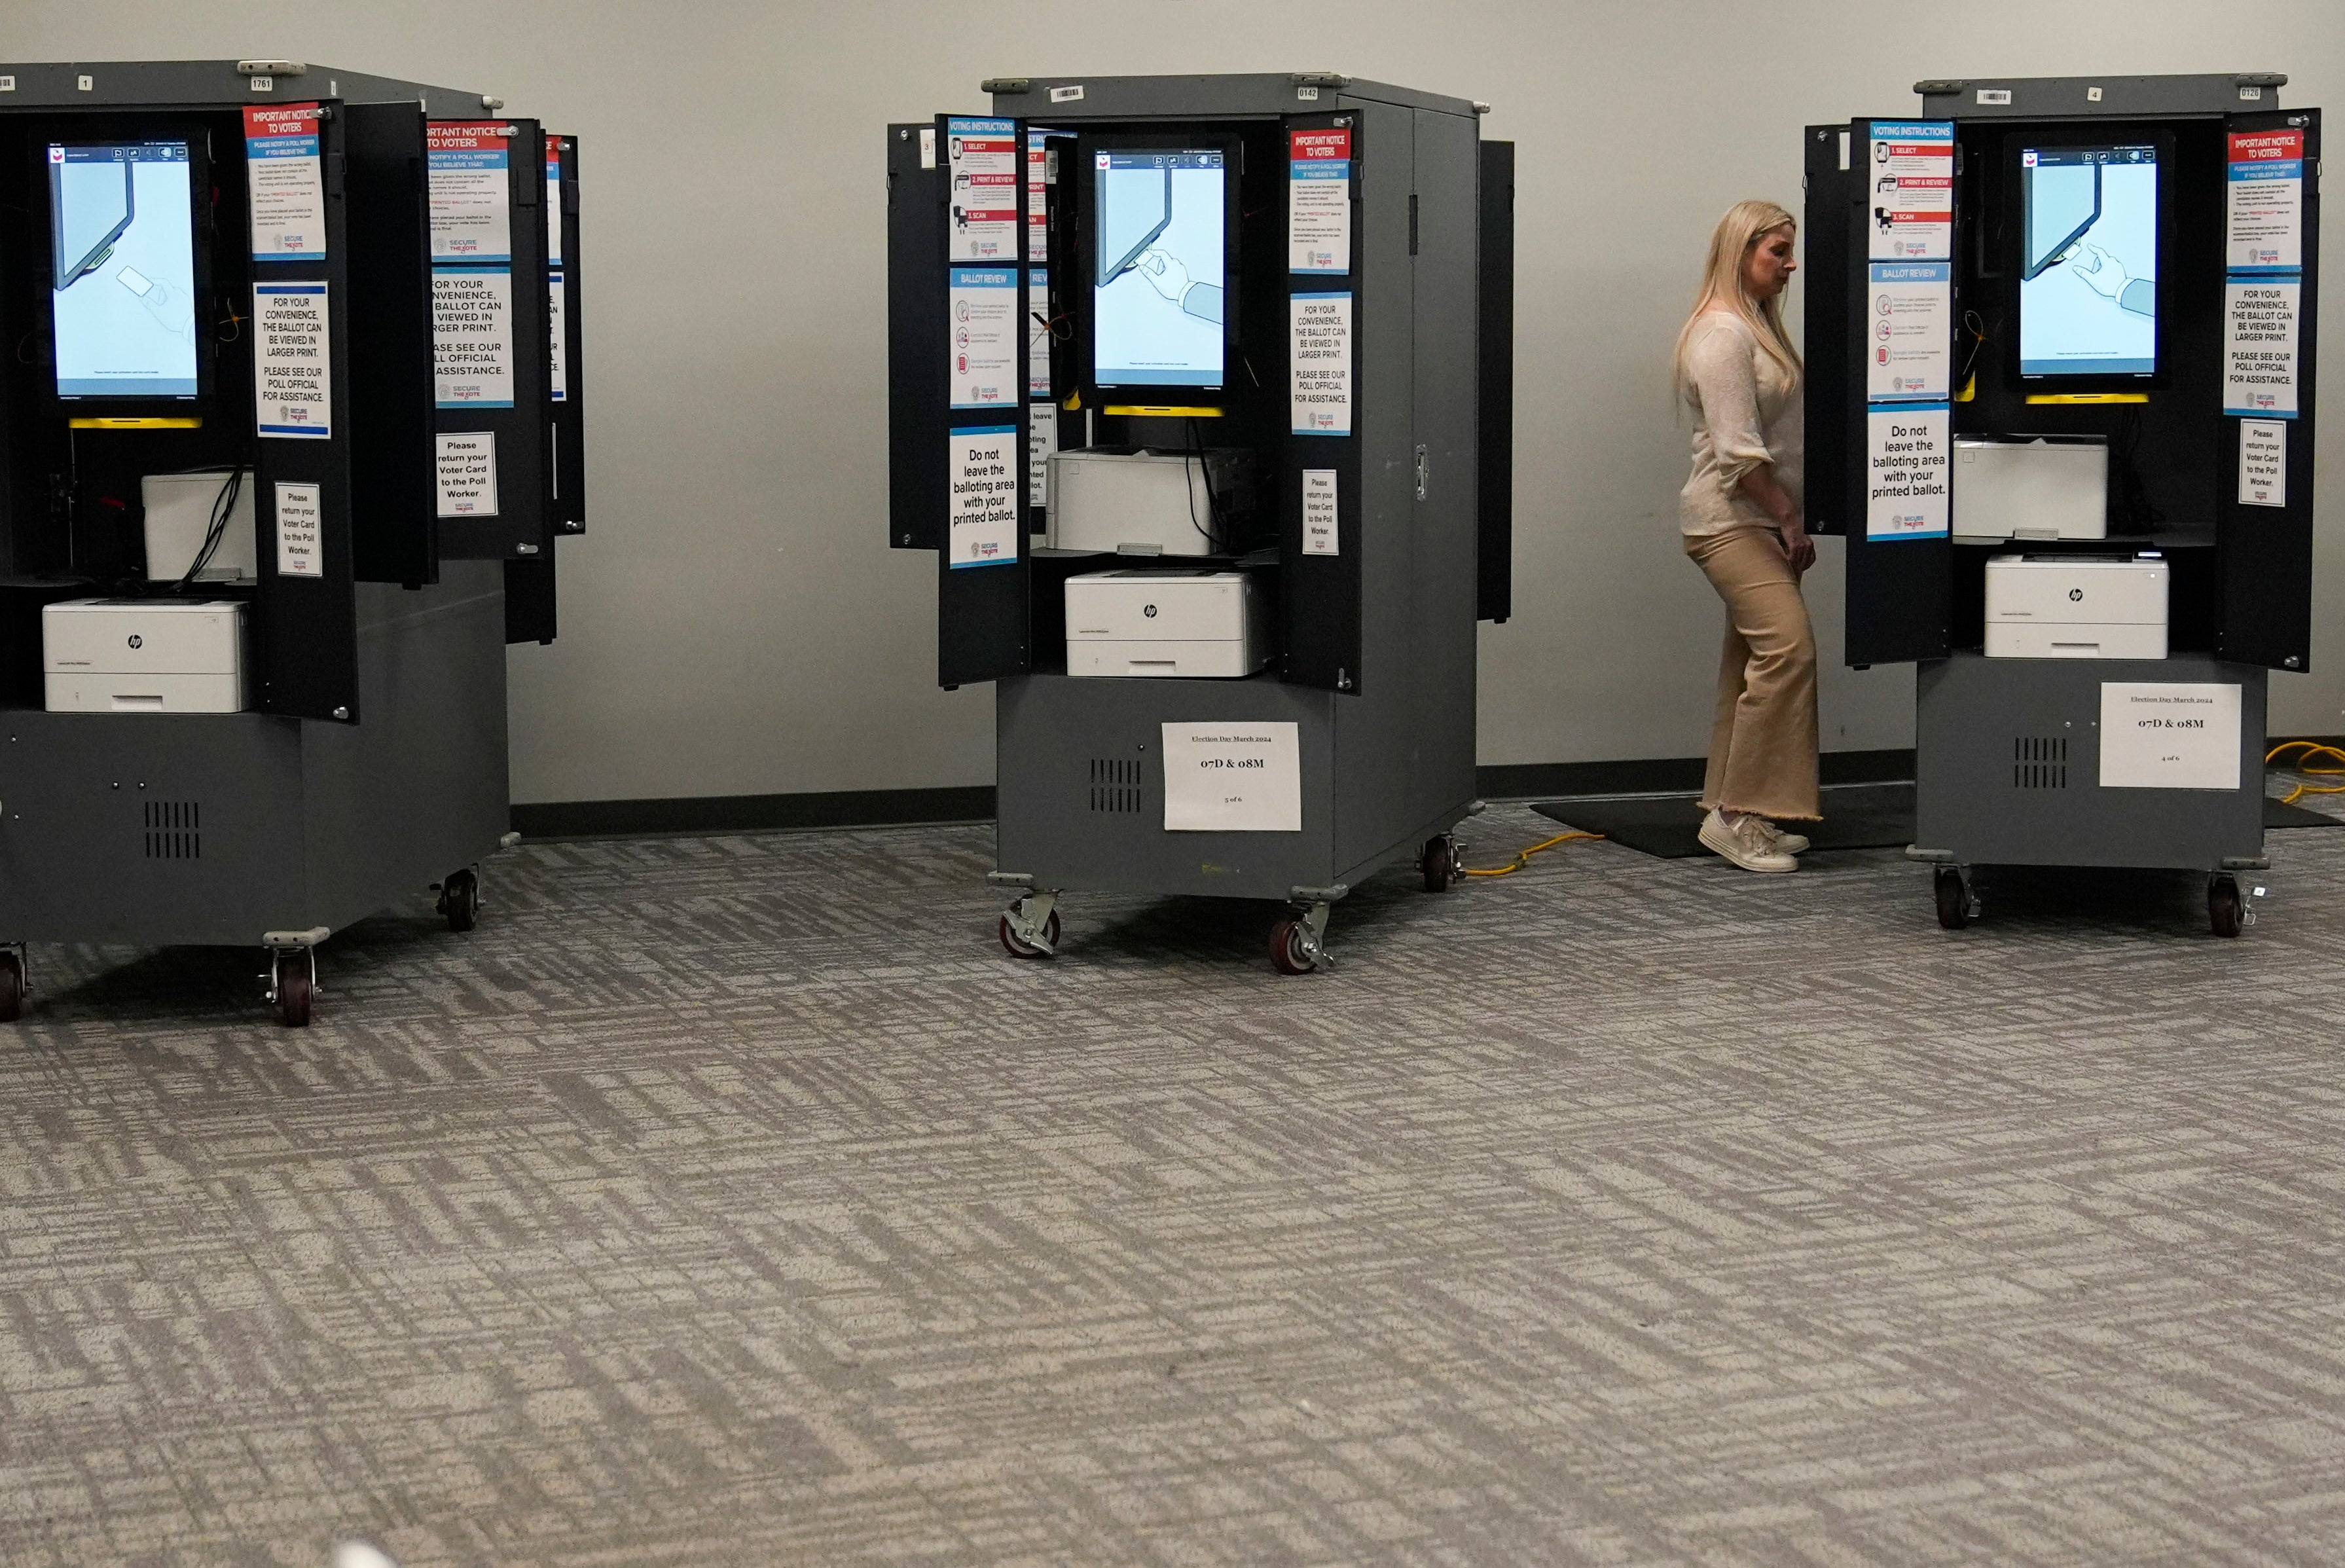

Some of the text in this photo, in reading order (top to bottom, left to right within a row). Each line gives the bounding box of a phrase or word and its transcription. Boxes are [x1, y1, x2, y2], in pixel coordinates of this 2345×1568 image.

[253, 79, 270, 88] 1761
[950, 121, 1013, 130] VOTING INSTRUCTIONS
[462, 127, 496, 136] NOTICE
[1900, 127, 1950, 136] INSTRUCTIONS
[441, 138, 477, 147] VOTERS
[1296, 136, 1345, 145] IMPORTANT NOTICE
[2236, 137, 2295, 148] IMPORTANT NOTICE
[1306, 147, 1335, 156] TO VOTERS
[2258, 149, 2281, 157] VOTERS
[1883, 269, 1936, 278] BALLOT REVIEW
[961, 274, 1007, 283] BALLOT REVIEW
[2236, 301, 2289, 310] CONVENIENCE,
[266, 311, 318, 320] CONVENIENCE,
[306, 323, 321, 332] CAN
[269, 336, 316, 344] BE VIEWED IN
[267, 348, 318, 357] LARGER PRINT.
[264, 367, 289, 376] PLEASE
[268, 380, 318, 389] POLL OFFICIAL
[263, 392, 323, 401] FOR ASSISTANCE.
[1892, 426, 1927, 437] Do not
[1885, 441, 1933, 452] leave the
[970, 449, 999, 460] Do not
[1874, 456, 1918, 468] balloting
[964, 465, 1004, 477] leave the
[1885, 471, 1933, 483] with your
[954, 481, 1014, 494] balloting area
[1873, 484, 1945, 500] printed ballot.
[964, 497, 1005, 509] with your
[954, 509, 1015, 527] printed ballot.
[2069, 589, 2082, 602] hp
[1144, 604, 1157, 618] hp
[128, 634, 142, 649] hp
[2139, 720, 2204, 729] 07D & 08M
[1201, 759, 1263, 769] 07D & 08M
